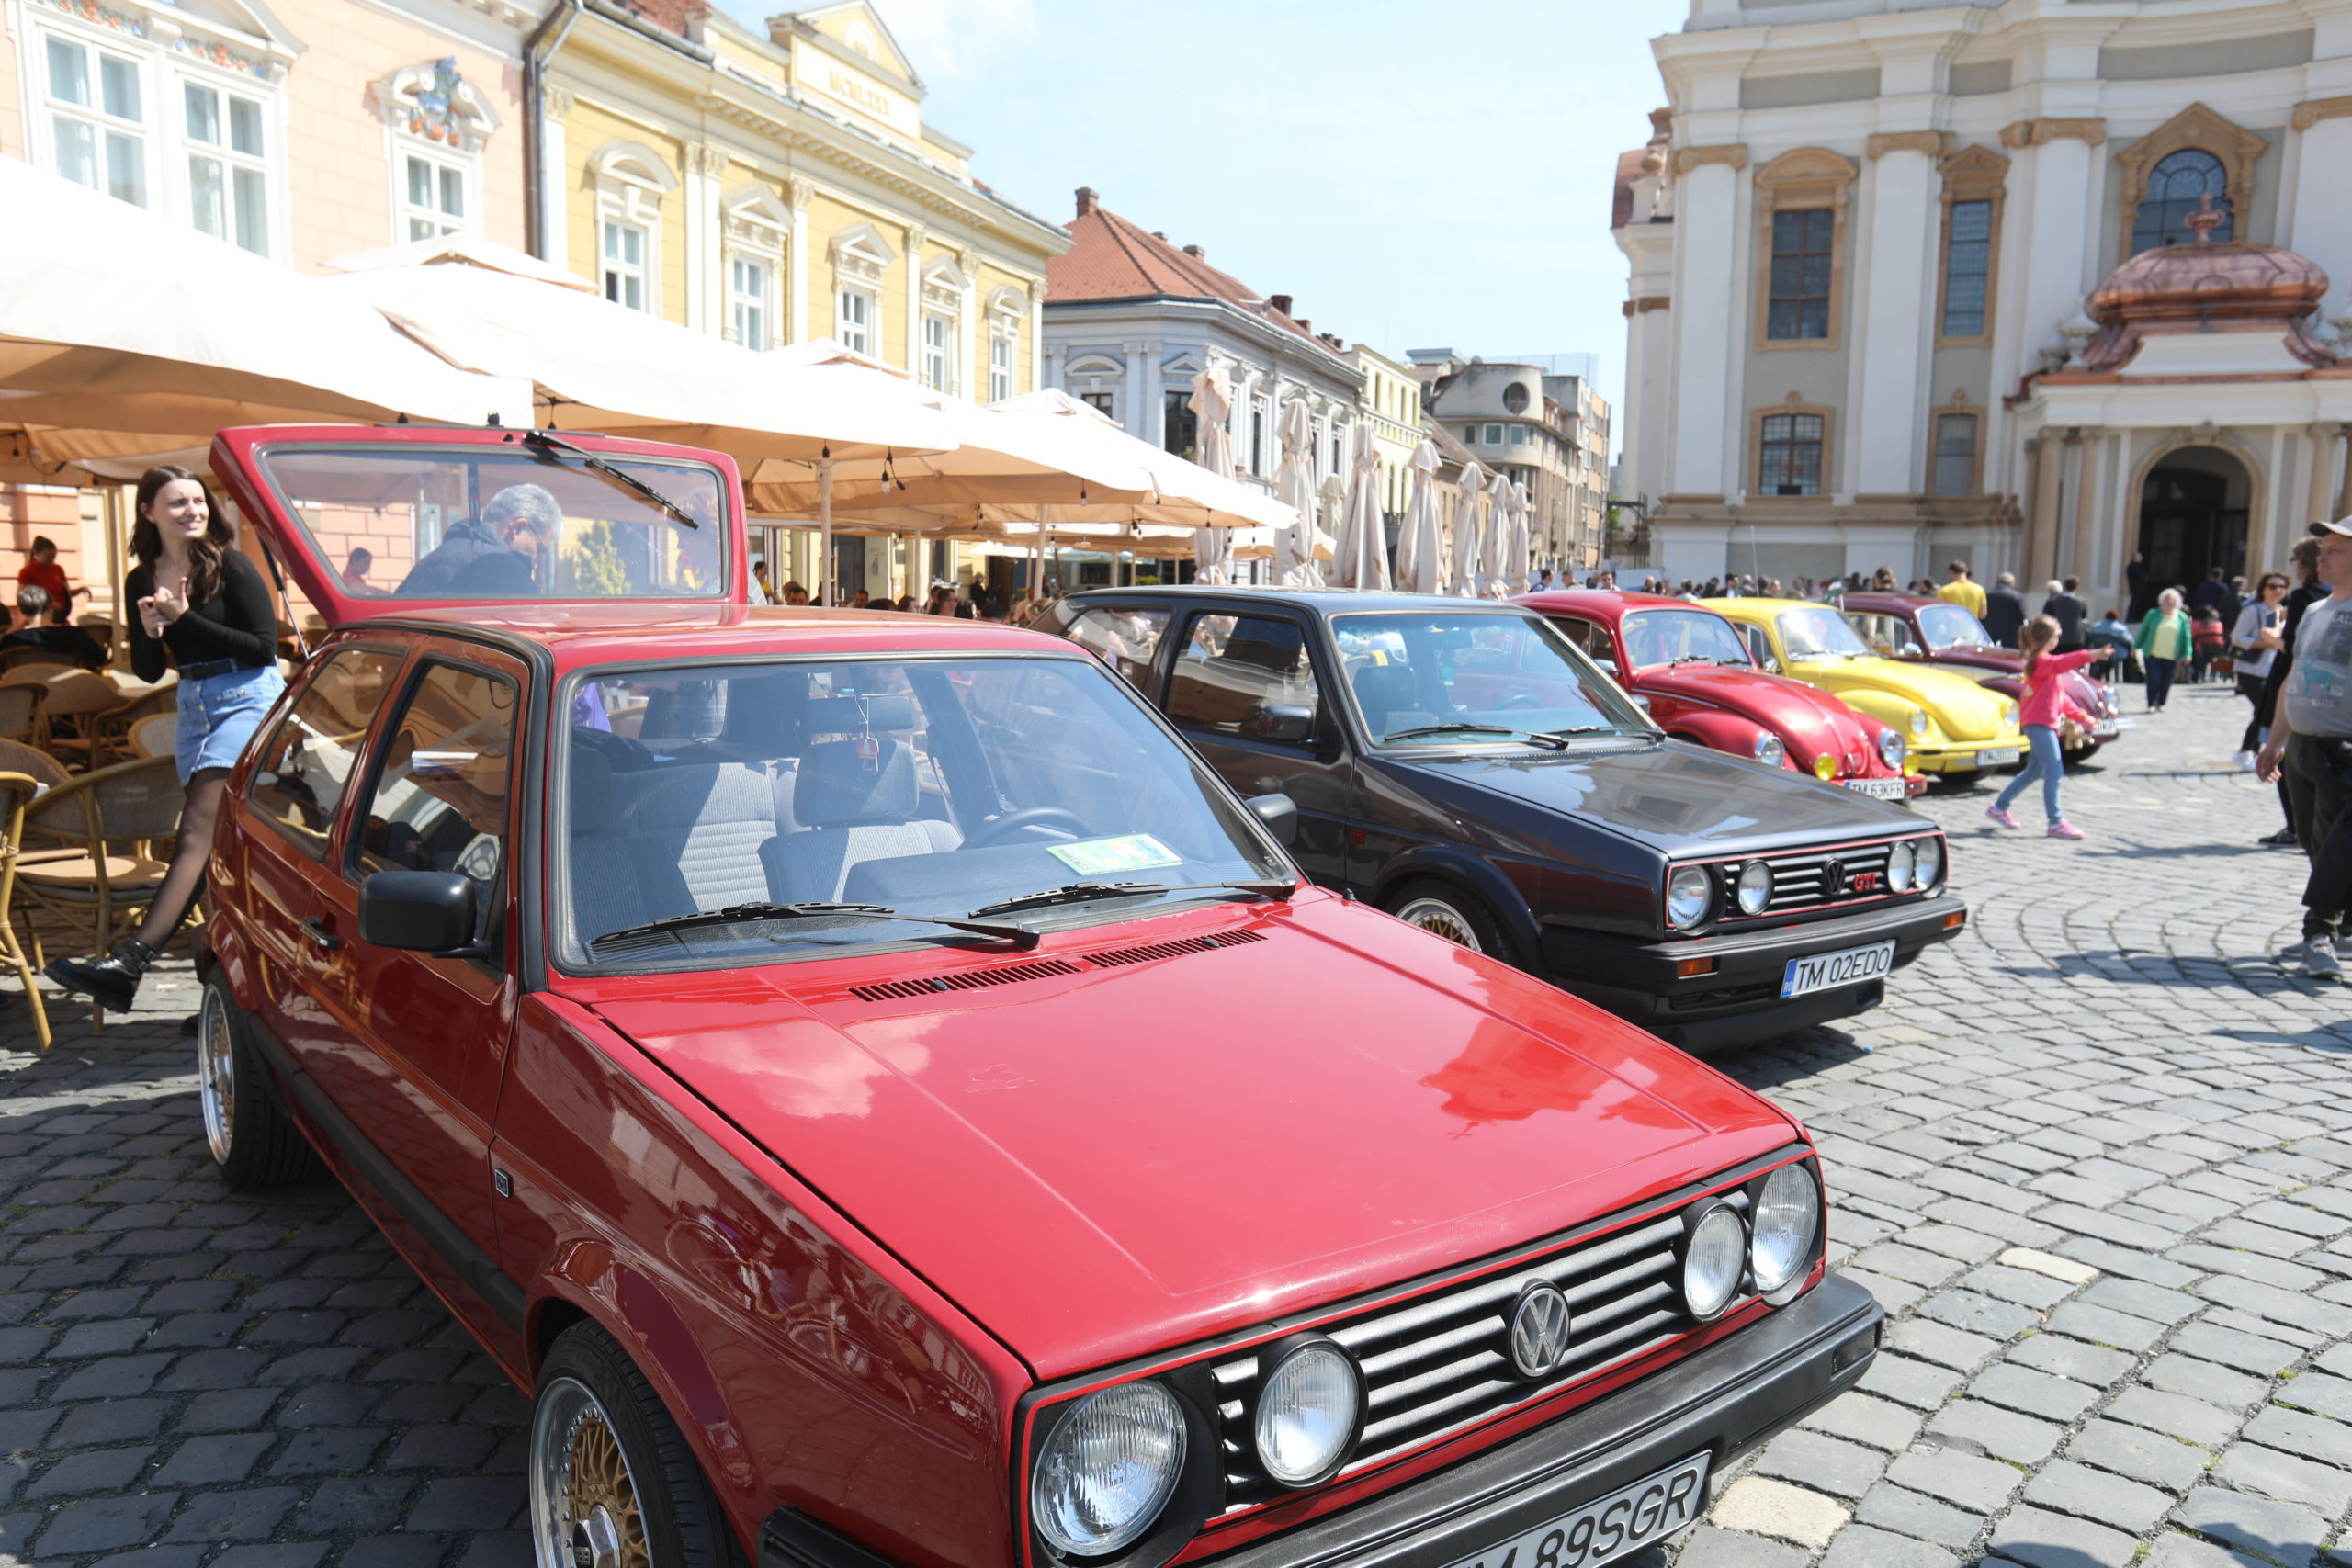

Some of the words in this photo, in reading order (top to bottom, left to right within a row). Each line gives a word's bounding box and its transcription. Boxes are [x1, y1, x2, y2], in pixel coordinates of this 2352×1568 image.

[1871, 782, 1904, 797] 63KFR
[1854, 873, 1878, 892] GTI
[1797, 960, 1826, 990] TM
[1829, 947, 1891, 983] 02EDO
[1511, 1287, 1570, 1377] VW
[1535, 1467, 1699, 1568] 89SGR
